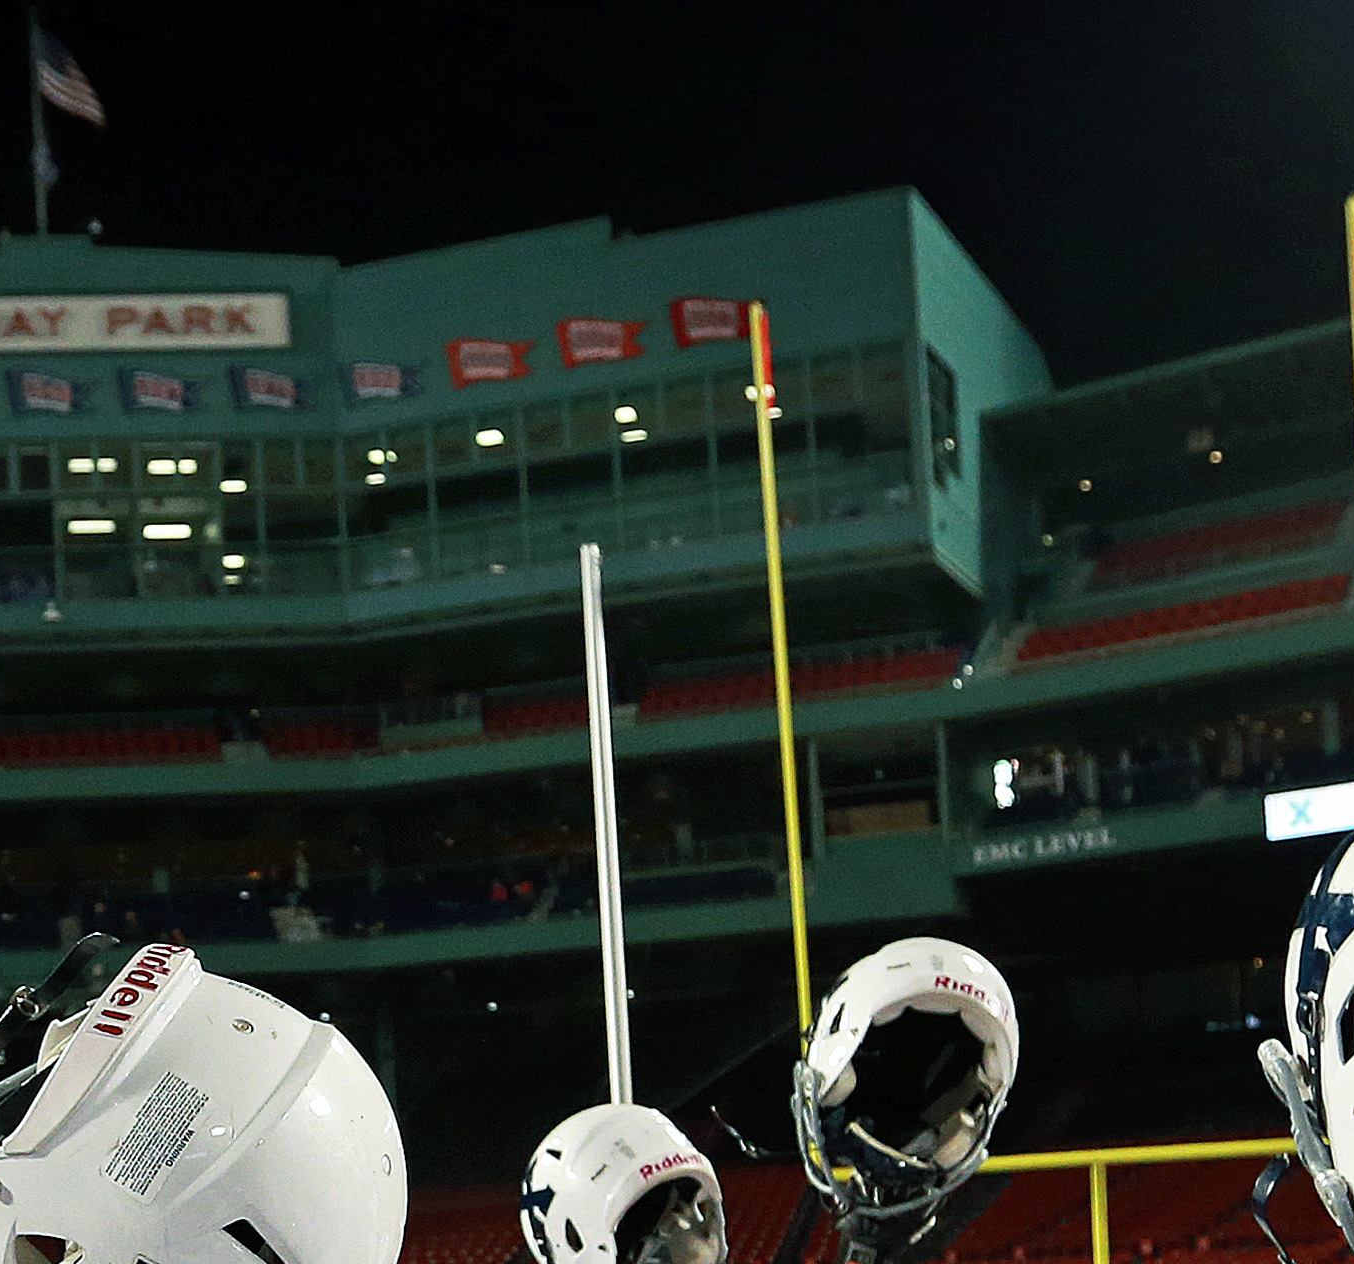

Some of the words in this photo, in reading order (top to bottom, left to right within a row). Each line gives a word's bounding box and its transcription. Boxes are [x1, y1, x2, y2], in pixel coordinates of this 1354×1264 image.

[105, 303, 257, 337] PARK
[1035, 826, 1115, 855] LEVEL
[92, 944, 188, 1037] Riddell
[934, 974, 1010, 1022] Riddll
[165, 1128, 196, 1168] WARNING
